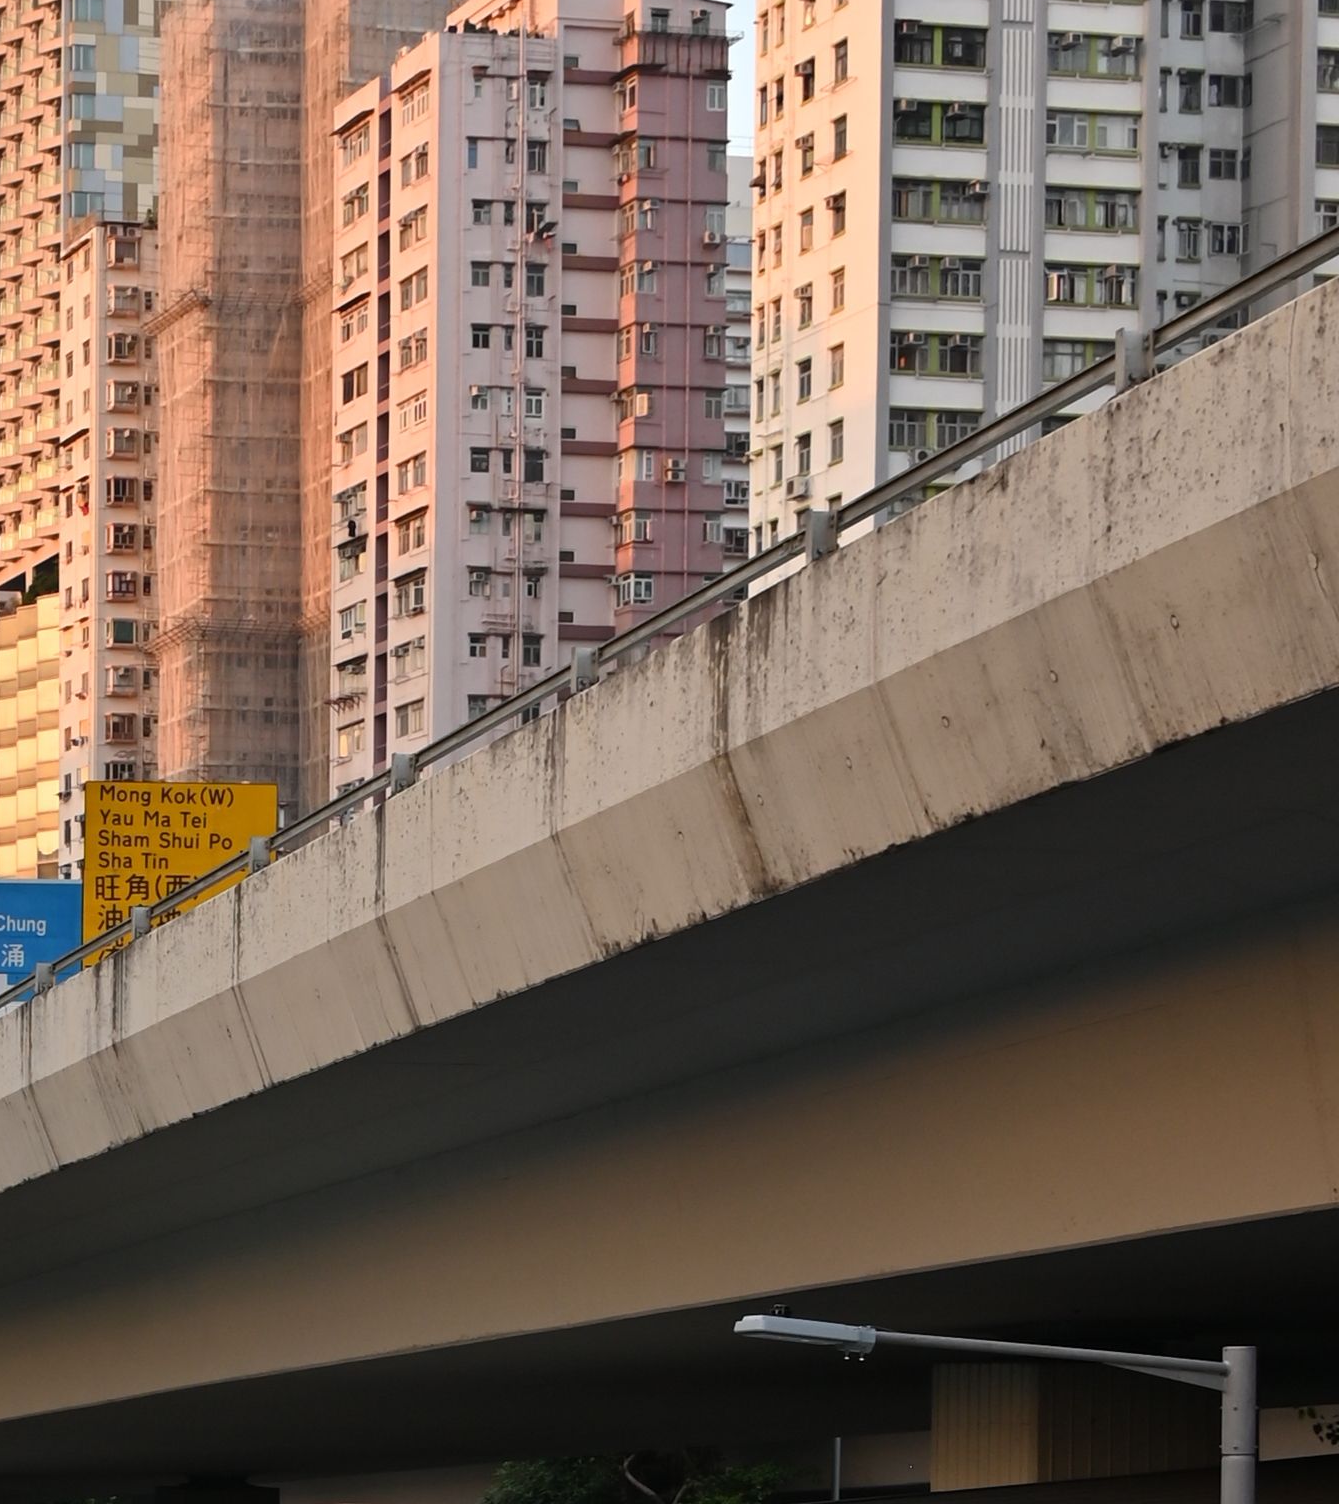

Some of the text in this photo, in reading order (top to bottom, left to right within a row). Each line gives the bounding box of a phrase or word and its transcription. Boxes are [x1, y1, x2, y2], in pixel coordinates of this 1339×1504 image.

[99, 785, 235, 808] Mong Kok(W)
[99, 809, 207, 829] Yau Ma Tei
[98, 829, 233, 851] Sham Shui Po
[98, 851, 169, 870] Sha Tin
